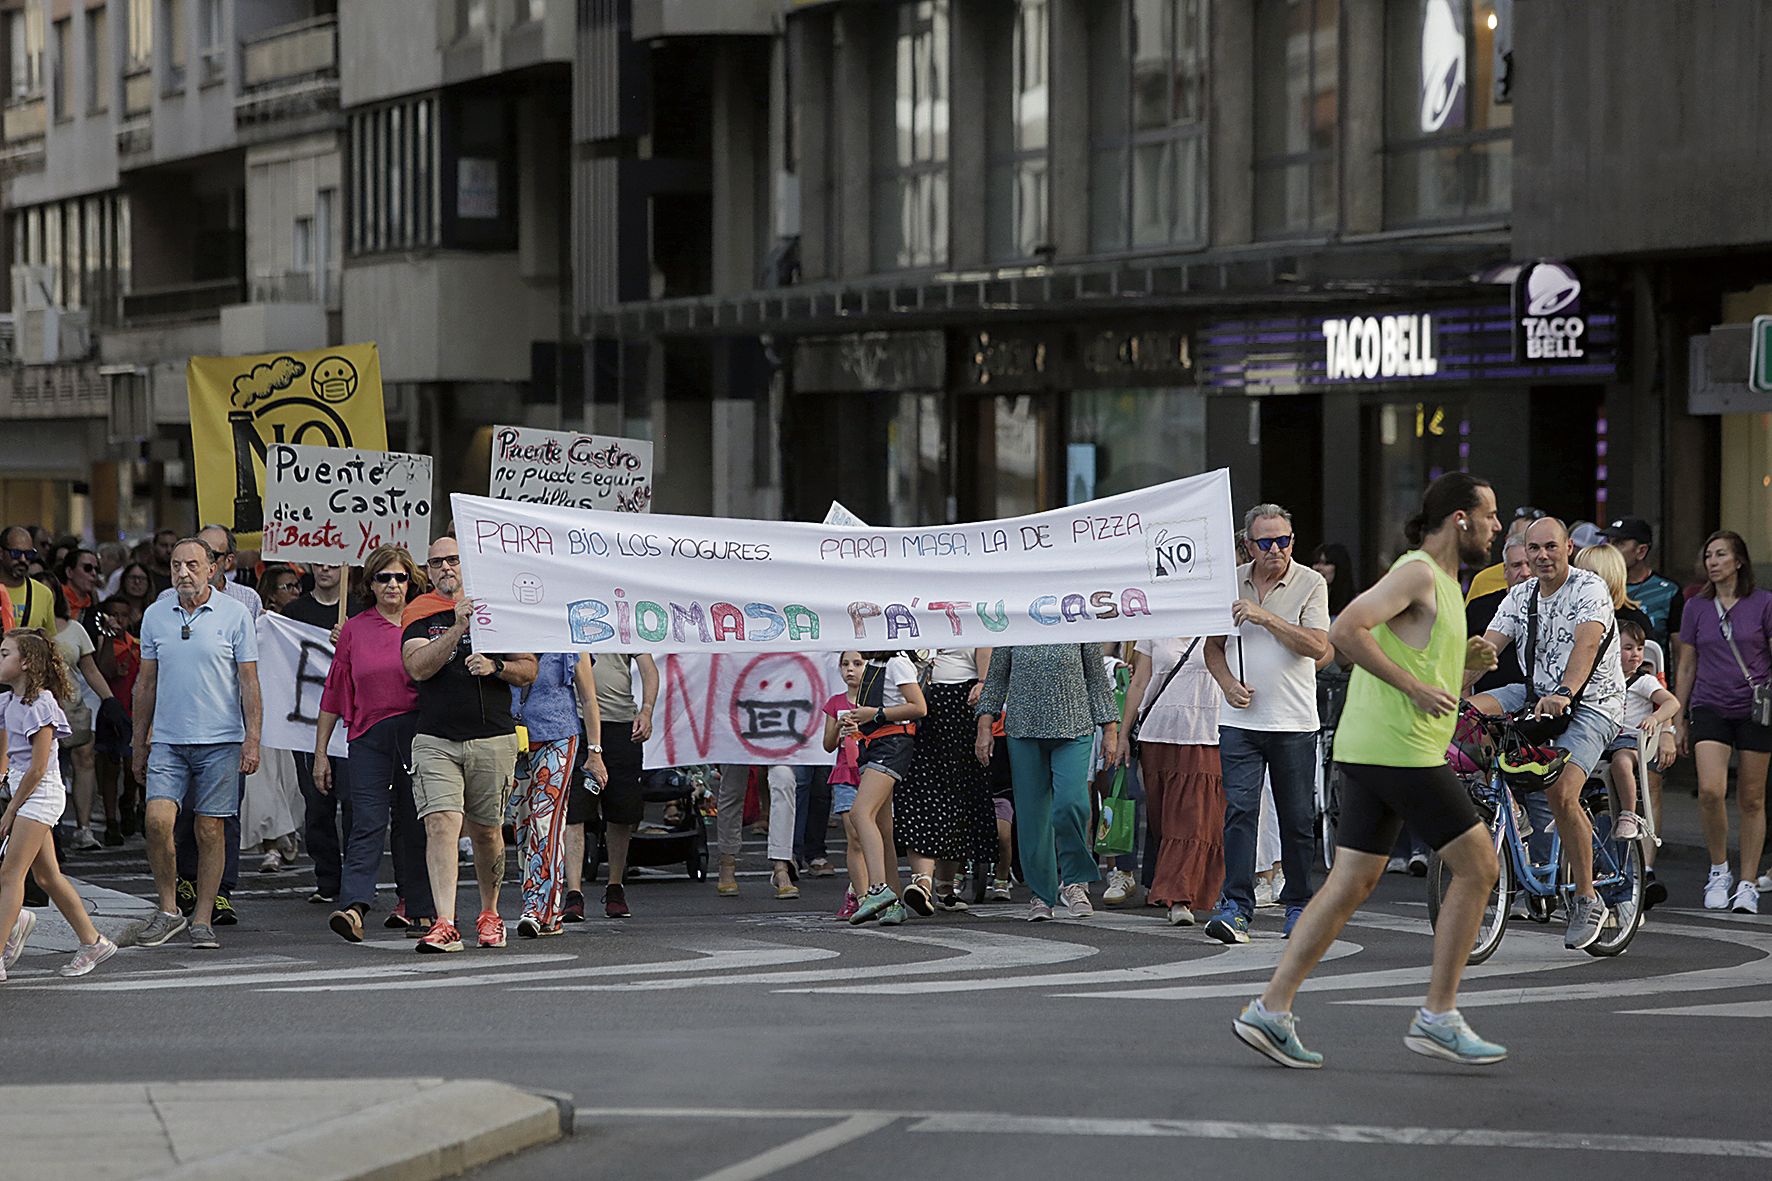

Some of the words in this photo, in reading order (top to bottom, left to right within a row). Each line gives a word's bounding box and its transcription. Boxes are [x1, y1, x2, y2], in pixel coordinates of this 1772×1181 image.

[1521, 317, 1584, 339] TACO
[1527, 338, 1584, 359] BELL
[276, 446, 384, 485] Puente
[497, 427, 564, 465] Puente
[568, 436, 642, 471] Castro
[495, 466, 516, 482] no
[519, 462, 575, 487] puede
[581, 471, 645, 497] seguir
[273, 502, 313, 521] dice
[329, 488, 430, 518] Castro
[475, 519, 554, 555] PARA
[616, 532, 662, 557] LOS
[668, 536, 772, 561] YOGURES.
[820, 535, 888, 561] PARA
[981, 529, 1008, 553] LA
[1019, 525, 1053, 550] DE
[1028, 587, 1152, 627] CASA
